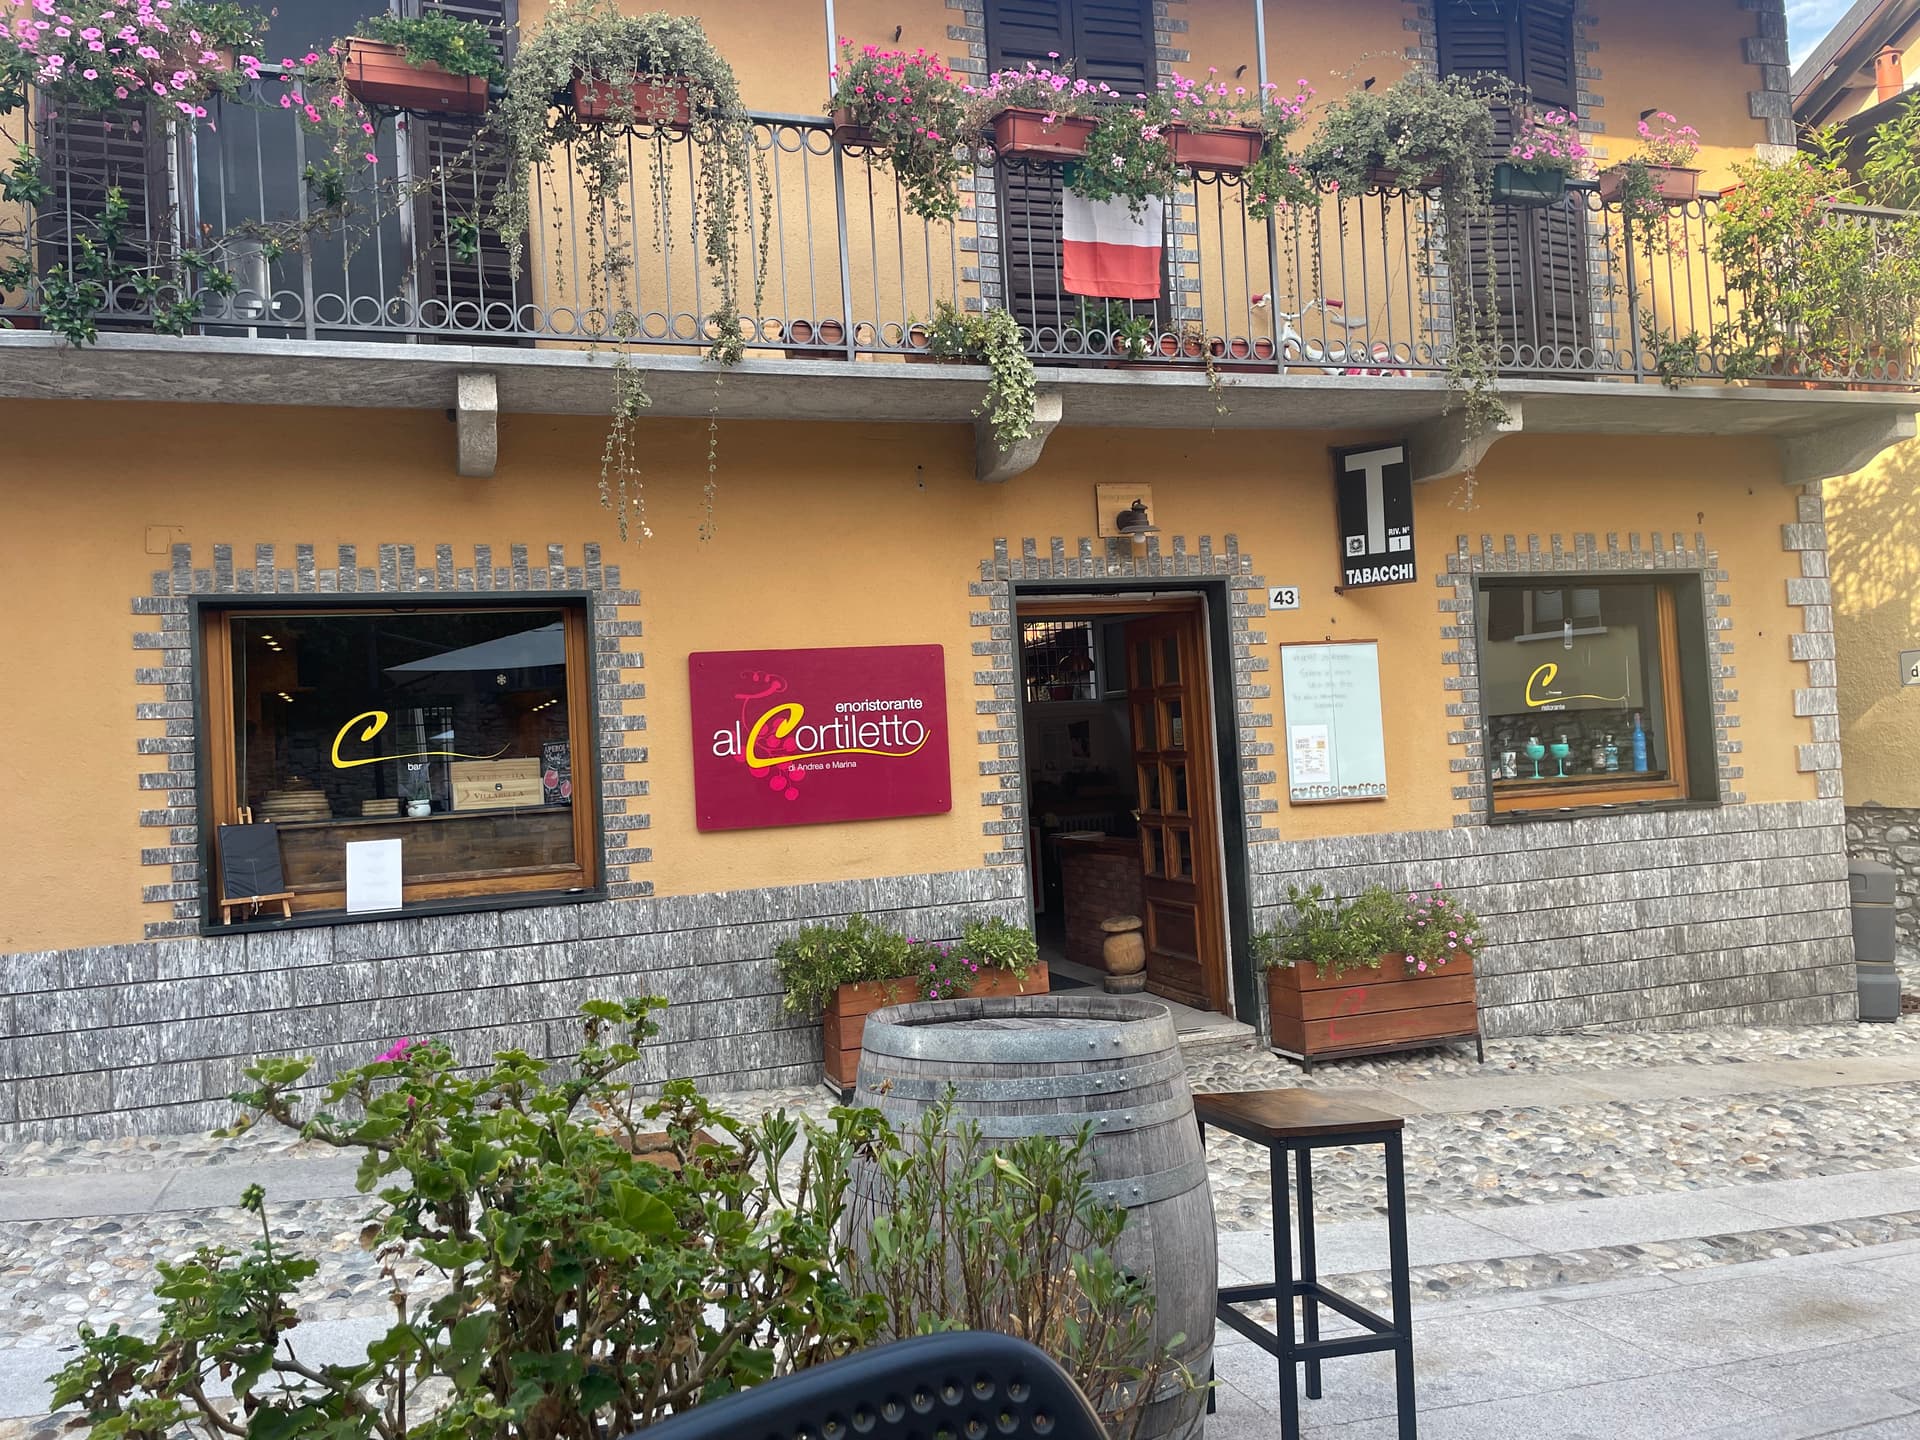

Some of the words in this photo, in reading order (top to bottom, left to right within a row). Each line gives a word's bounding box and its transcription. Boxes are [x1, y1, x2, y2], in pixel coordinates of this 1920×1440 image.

[1345, 446, 1403, 554] T
[1346, 563, 1414, 585] TABACCHI
[1273, 590, 1295, 606] 43
[835, 697, 923, 713] enoristorante
[712, 720, 742, 757] al
[746, 703, 931, 768] Cortiletto
[407, 762, 423, 771] bar
[788, 763, 796, 772] di
[797, 762, 824, 771] Andrea
[825, 762, 831, 770] e
[832, 760, 857, 769] Marina
